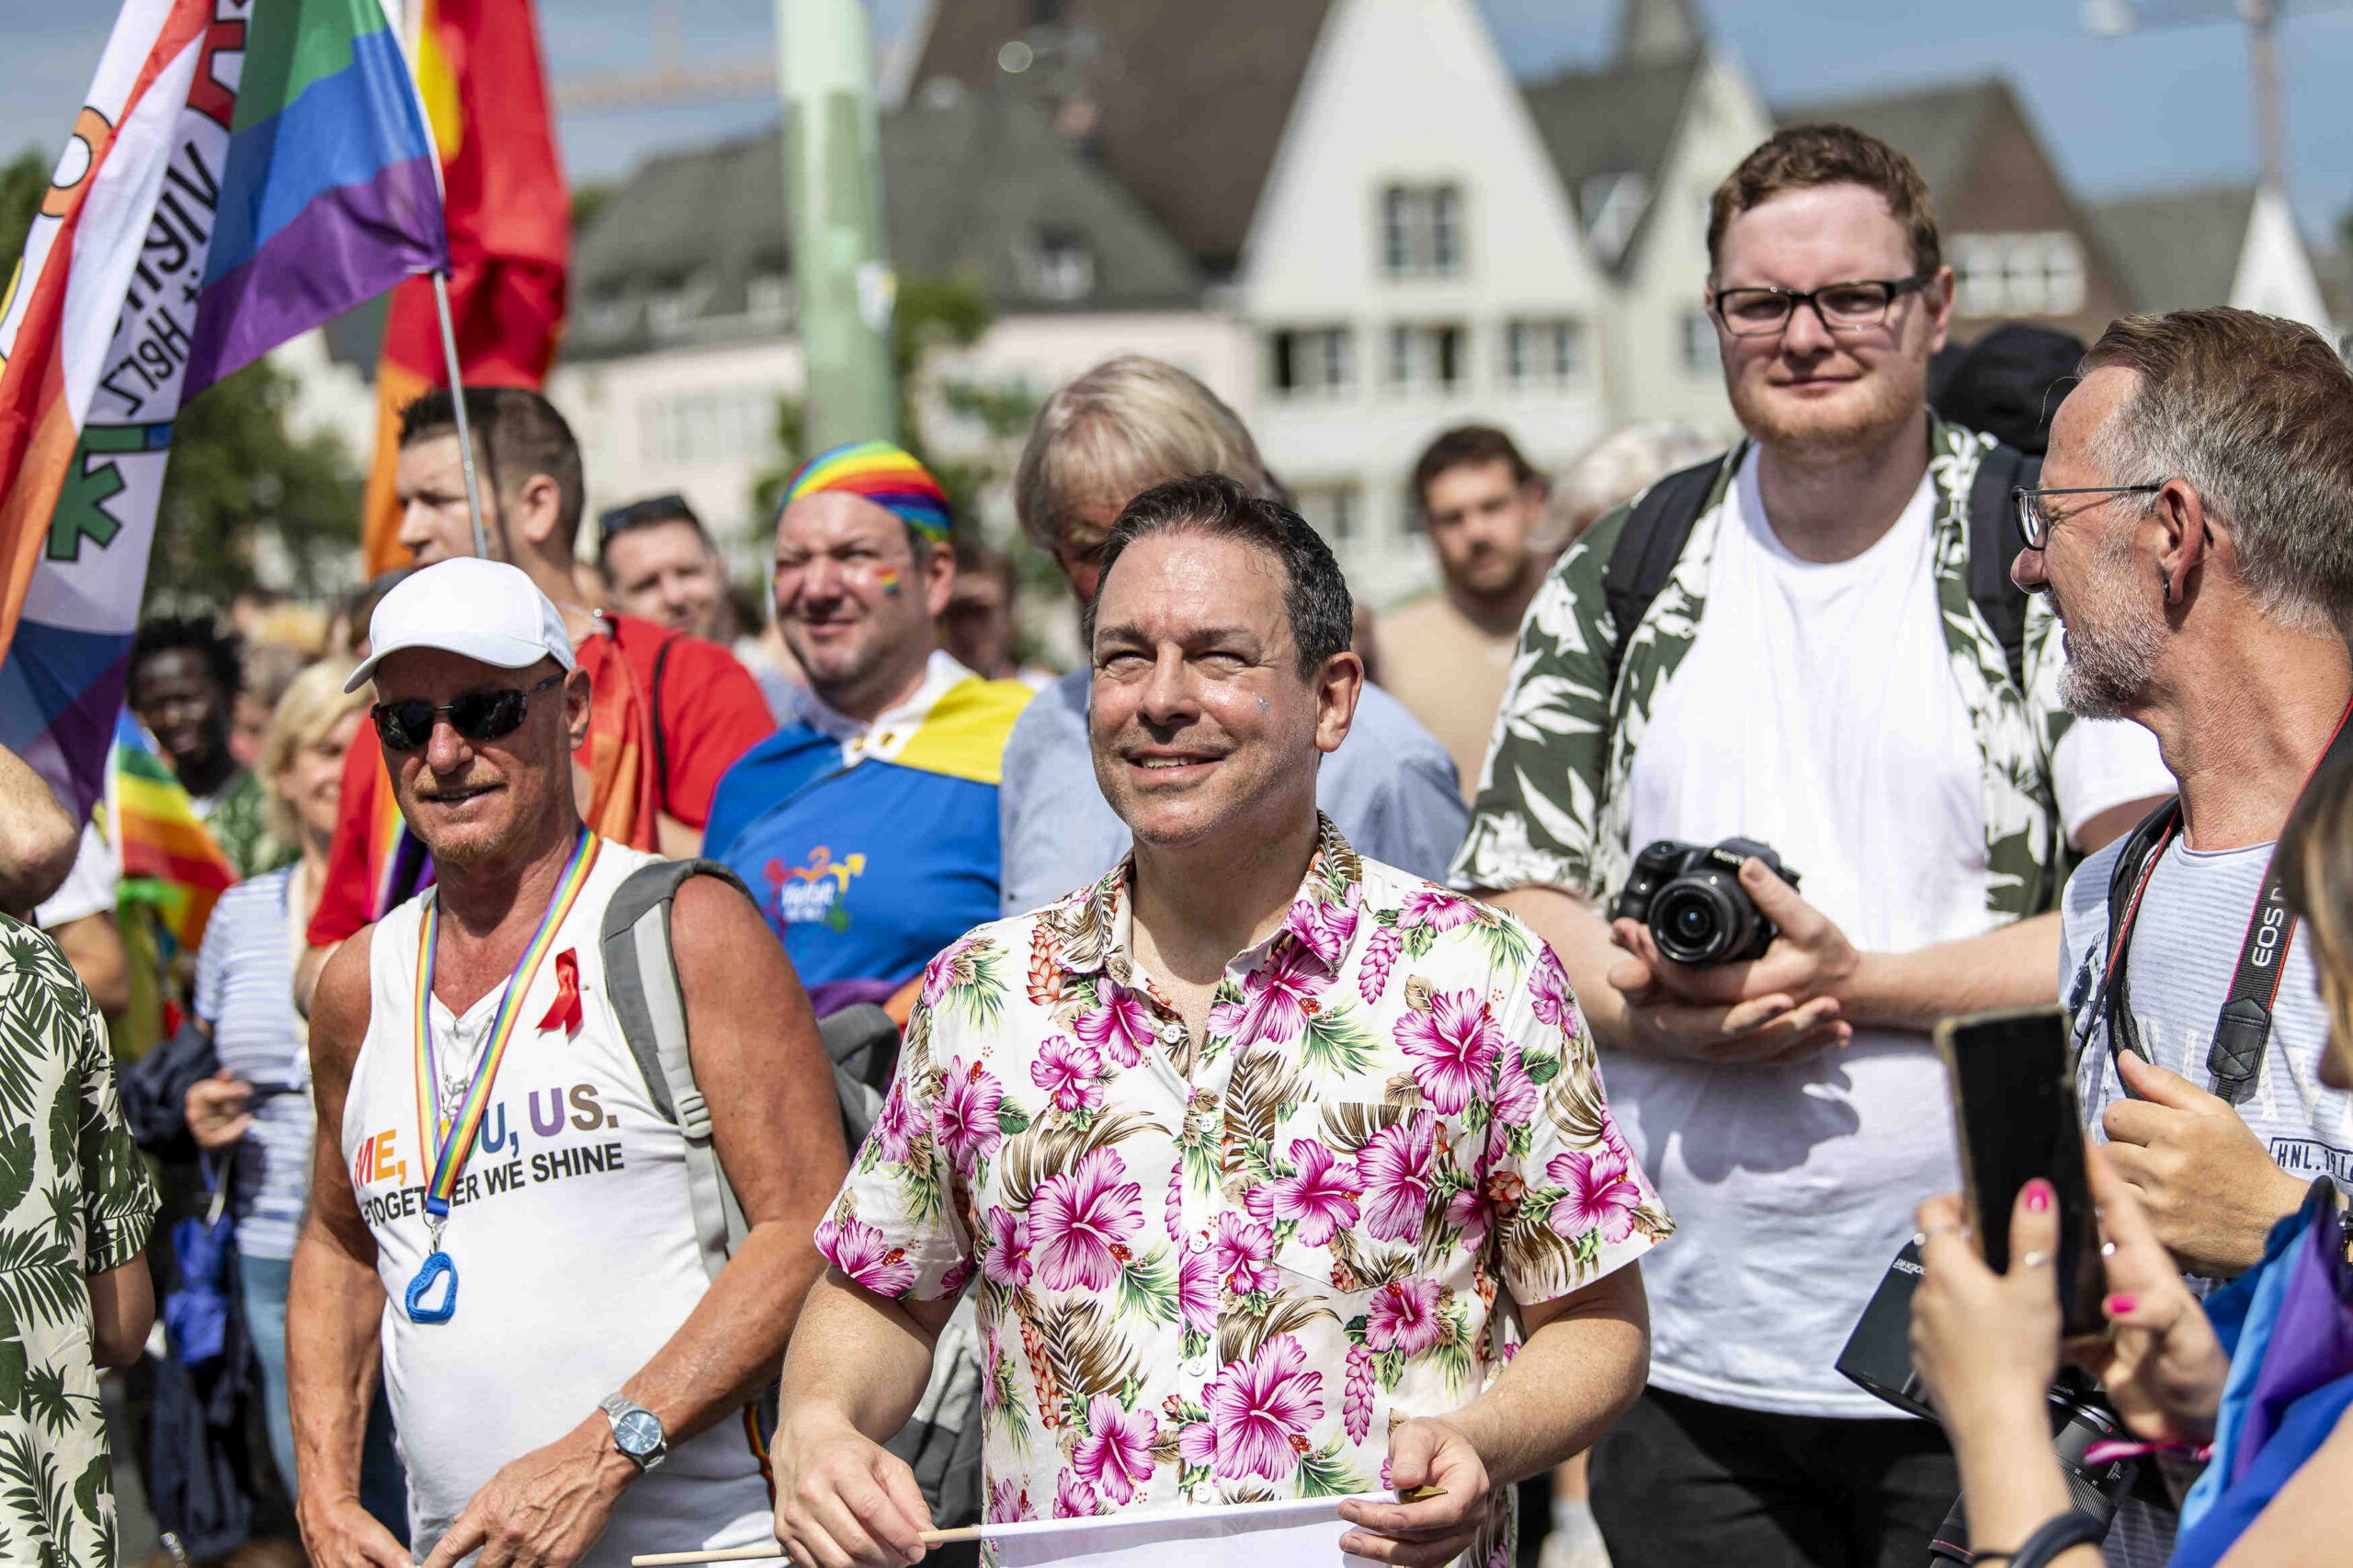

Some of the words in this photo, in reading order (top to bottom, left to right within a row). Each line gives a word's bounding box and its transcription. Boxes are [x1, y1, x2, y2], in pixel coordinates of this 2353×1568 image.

[2251, 907, 2284, 967] EOS
[355, 1130, 406, 1190] ME,
[529, 1084, 619, 1137] US.
[483, 1160, 525, 1196] WE
[531, 1142, 625, 1183] SHINE
